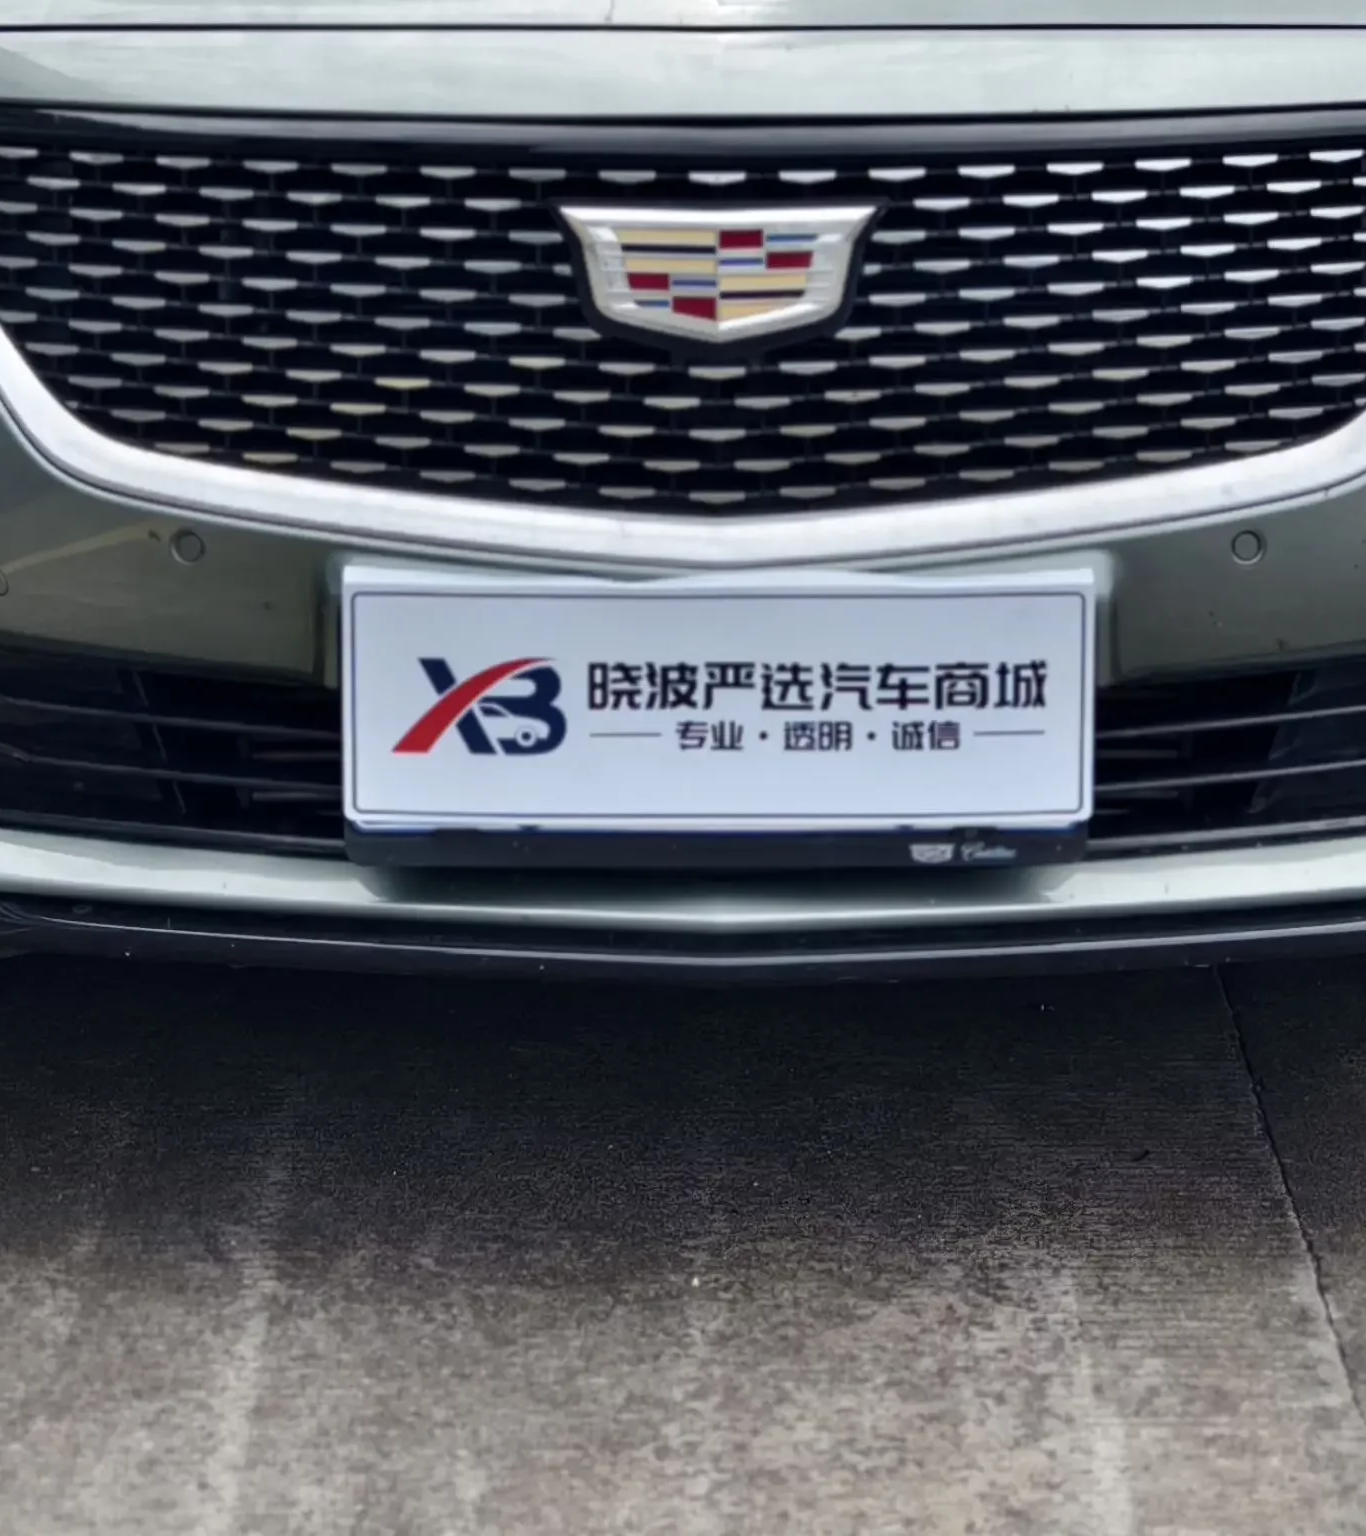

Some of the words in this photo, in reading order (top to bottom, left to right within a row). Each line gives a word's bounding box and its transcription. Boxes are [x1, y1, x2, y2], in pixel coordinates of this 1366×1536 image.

[587, 660, 1047, 711] 晓波严选汽车商城
